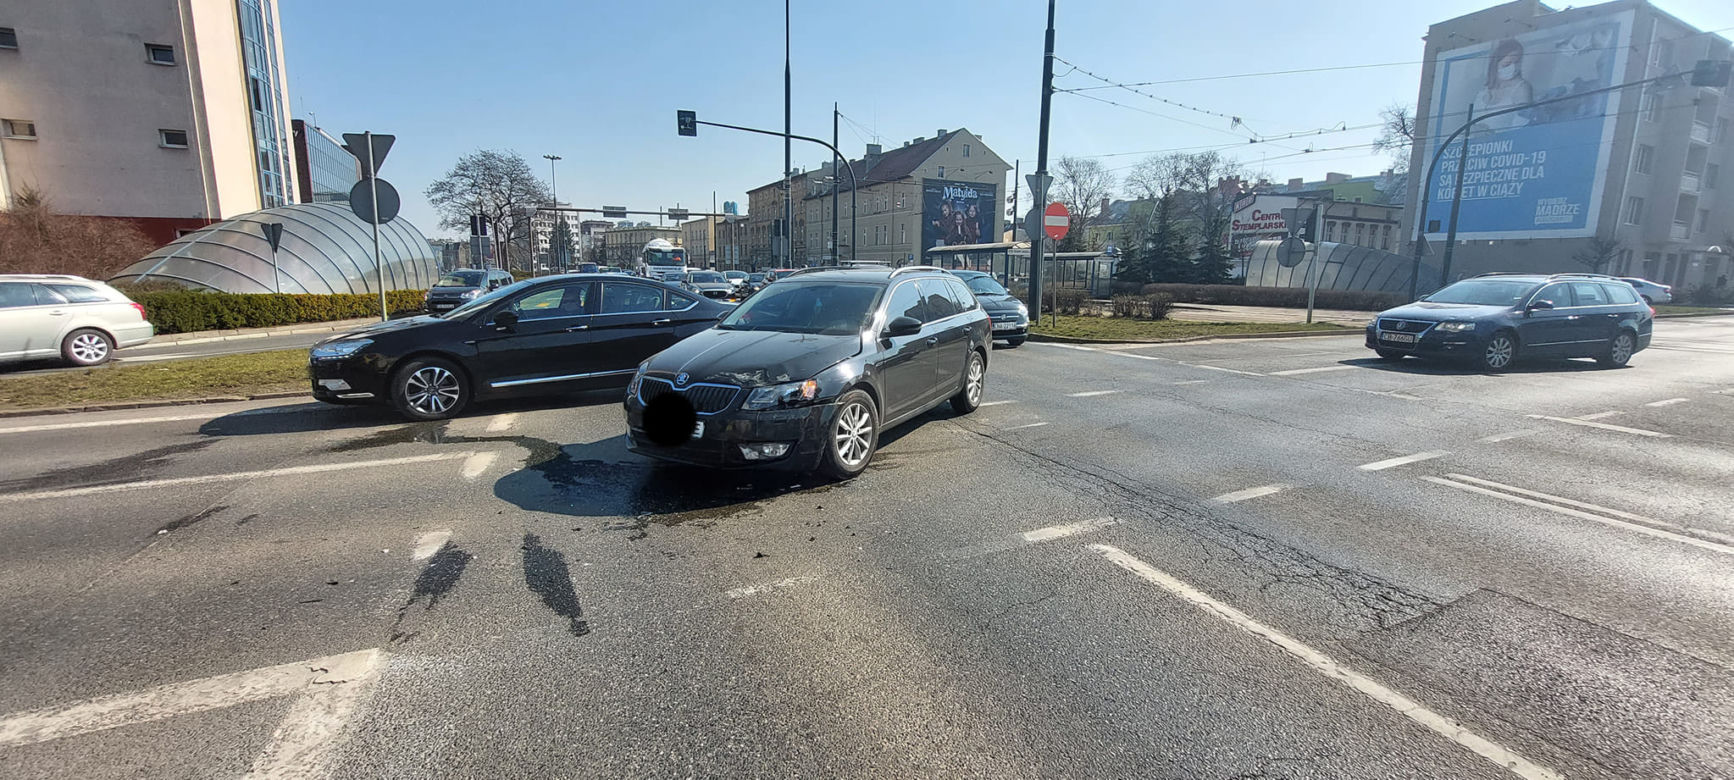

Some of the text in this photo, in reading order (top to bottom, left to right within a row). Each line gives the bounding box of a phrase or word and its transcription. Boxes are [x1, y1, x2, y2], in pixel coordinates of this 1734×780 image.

[1443, 140, 1513, 159] SZCEPIONKI
[1441, 150, 1546, 173] PRZCIW COVID-19
[1521, 166, 1544, 180] DLA
[1437, 186, 1477, 200] KOET
[1477, 184, 1489, 197] W
